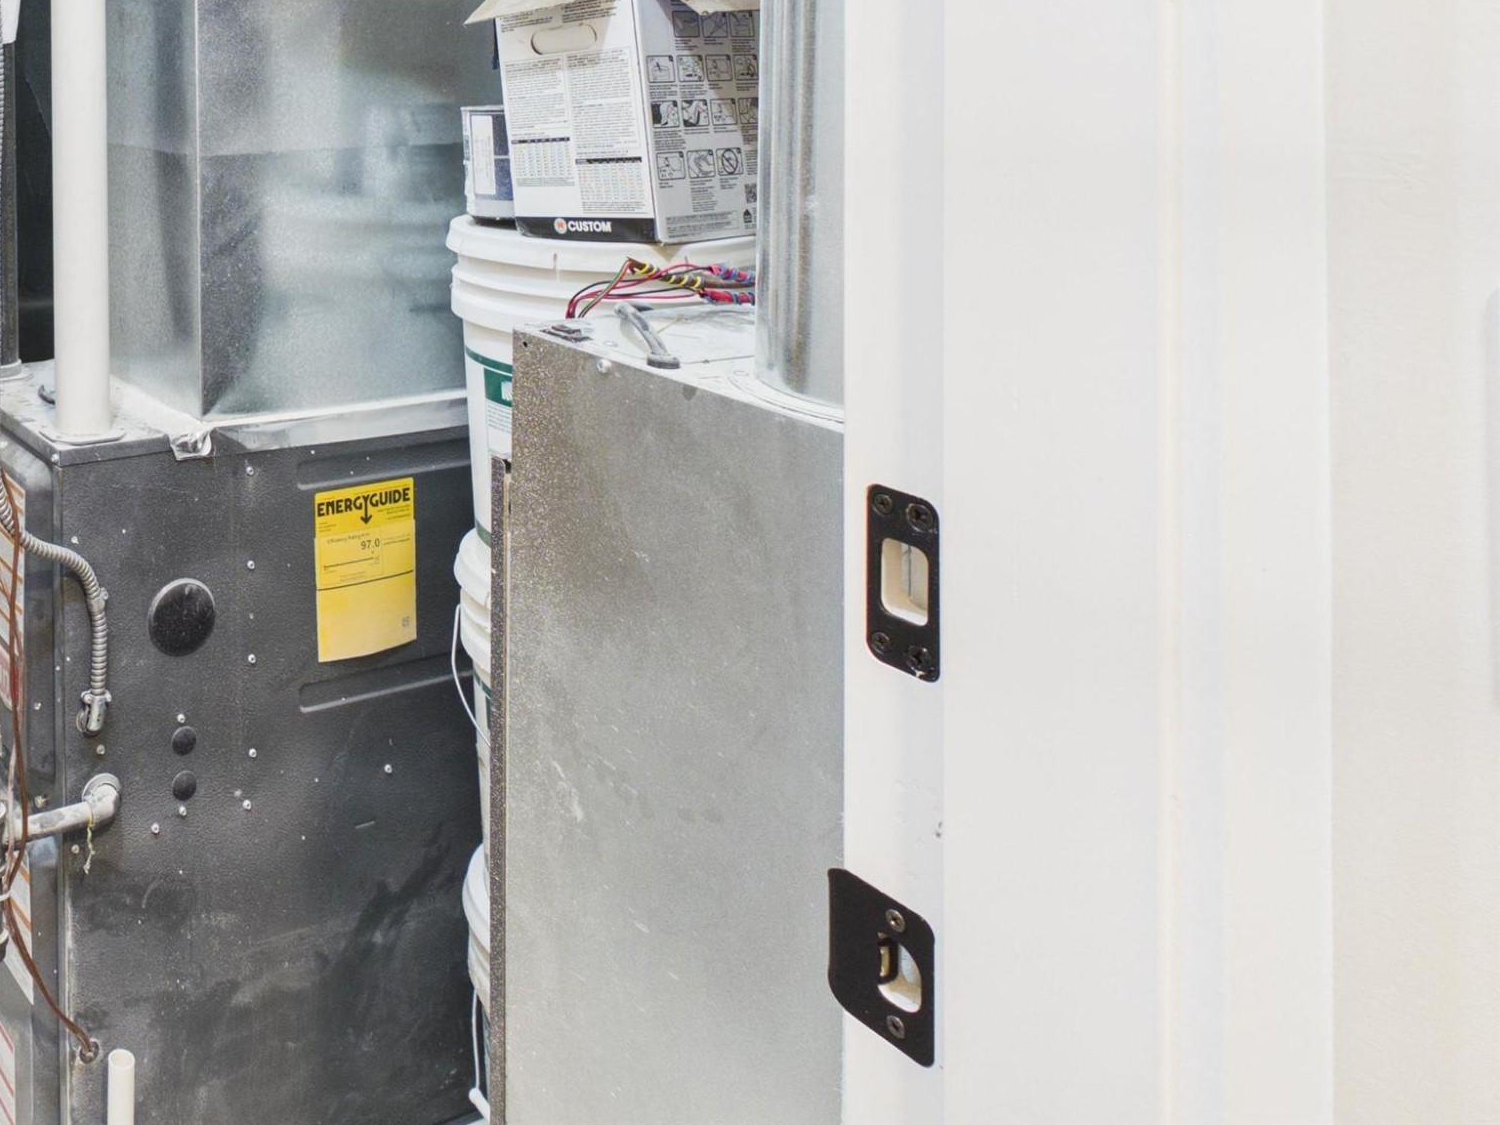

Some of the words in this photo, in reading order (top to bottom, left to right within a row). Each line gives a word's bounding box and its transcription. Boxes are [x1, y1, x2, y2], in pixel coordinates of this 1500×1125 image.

[567, 220, 612, 232] CUSTOM
[317, 487, 410, 518] ENERGYGUIDE
[361, 538, 380, 550] 97.0
